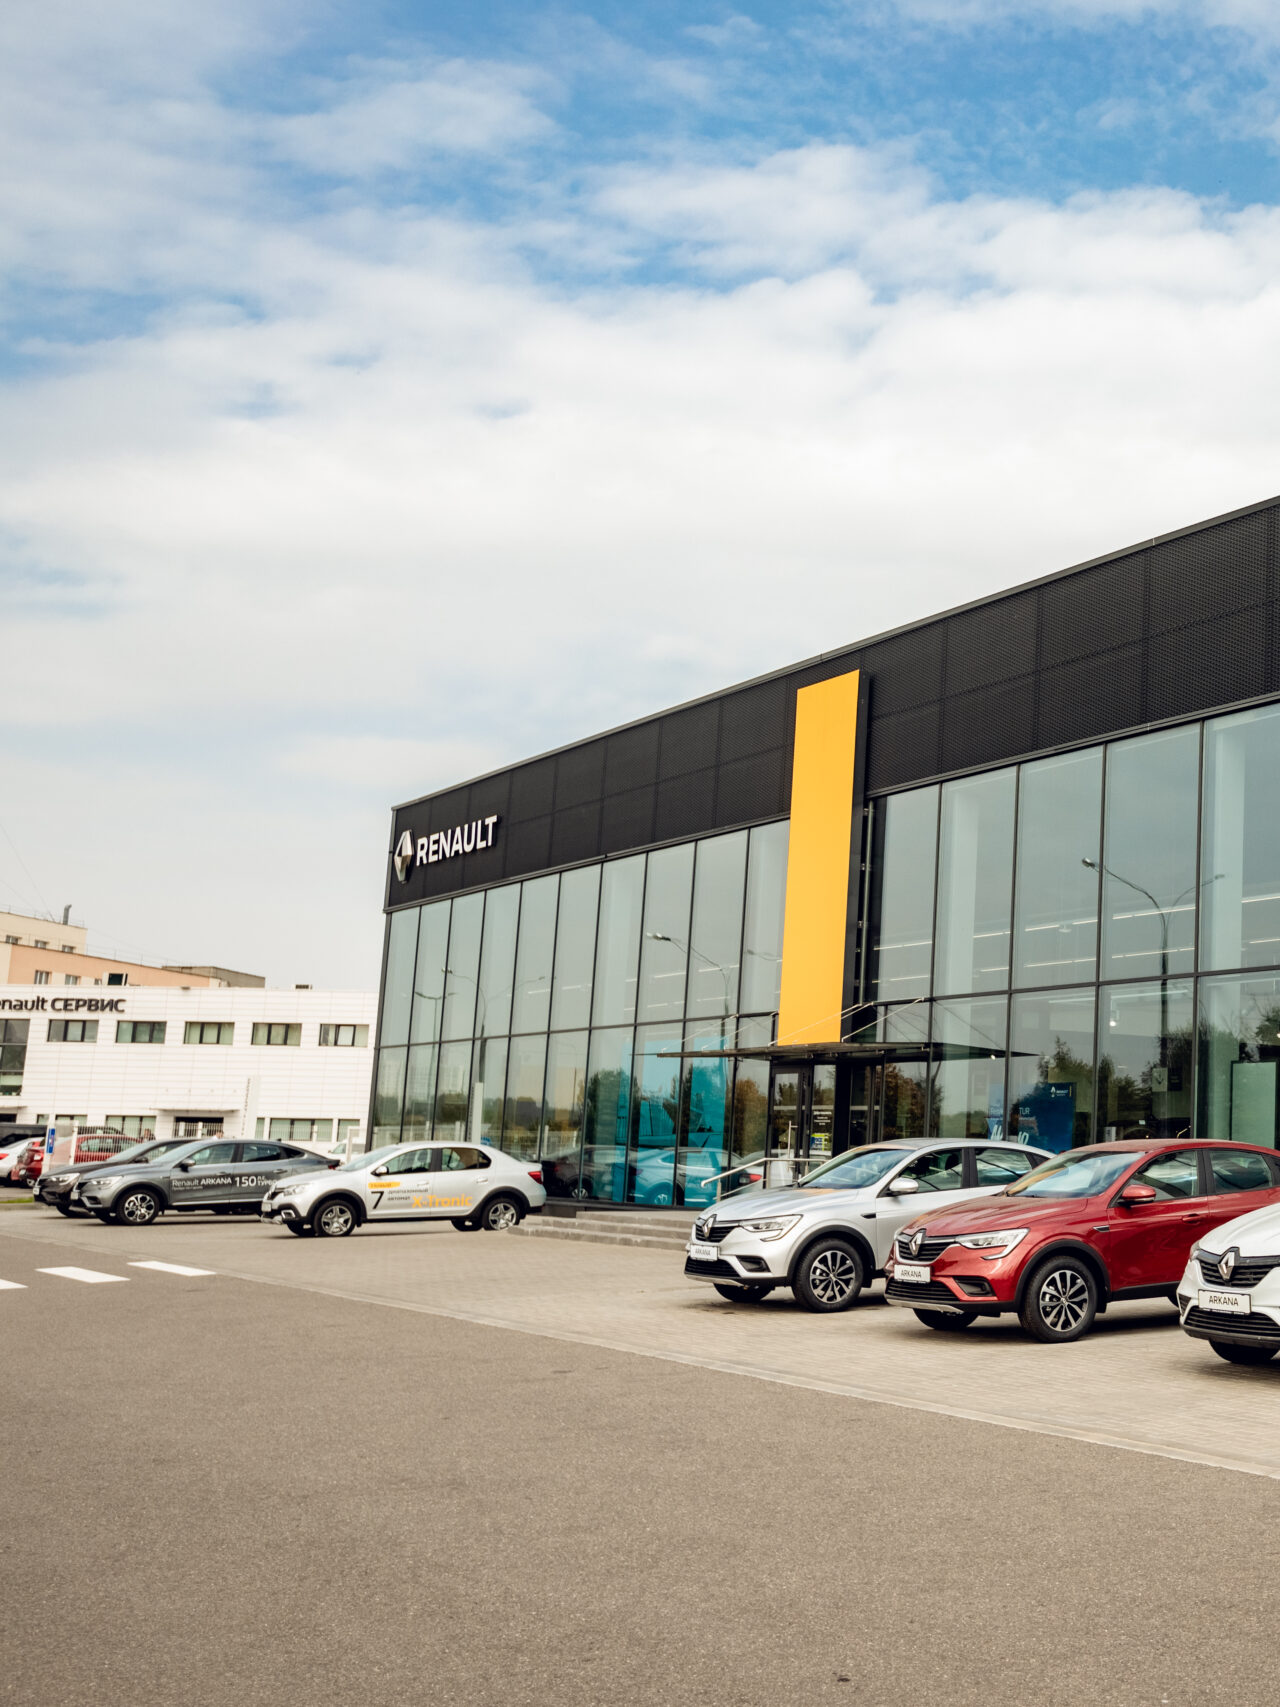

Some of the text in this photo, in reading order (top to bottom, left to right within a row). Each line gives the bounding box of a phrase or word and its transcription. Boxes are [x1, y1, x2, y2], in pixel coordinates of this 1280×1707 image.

[416, 814, 498, 867] RENAULT
[0, 996, 126, 1013] nault СЕРВИС
[200, 1177, 233, 1186] ARKANA
[235, 1175, 257, 1187] 150
[371, 1190, 385, 1210] 7
[412, 1193, 473, 1209] X-Tronic
[901, 1269, 922, 1279] ARKANA
[1208, 1295, 1239, 1307] ARKANA
